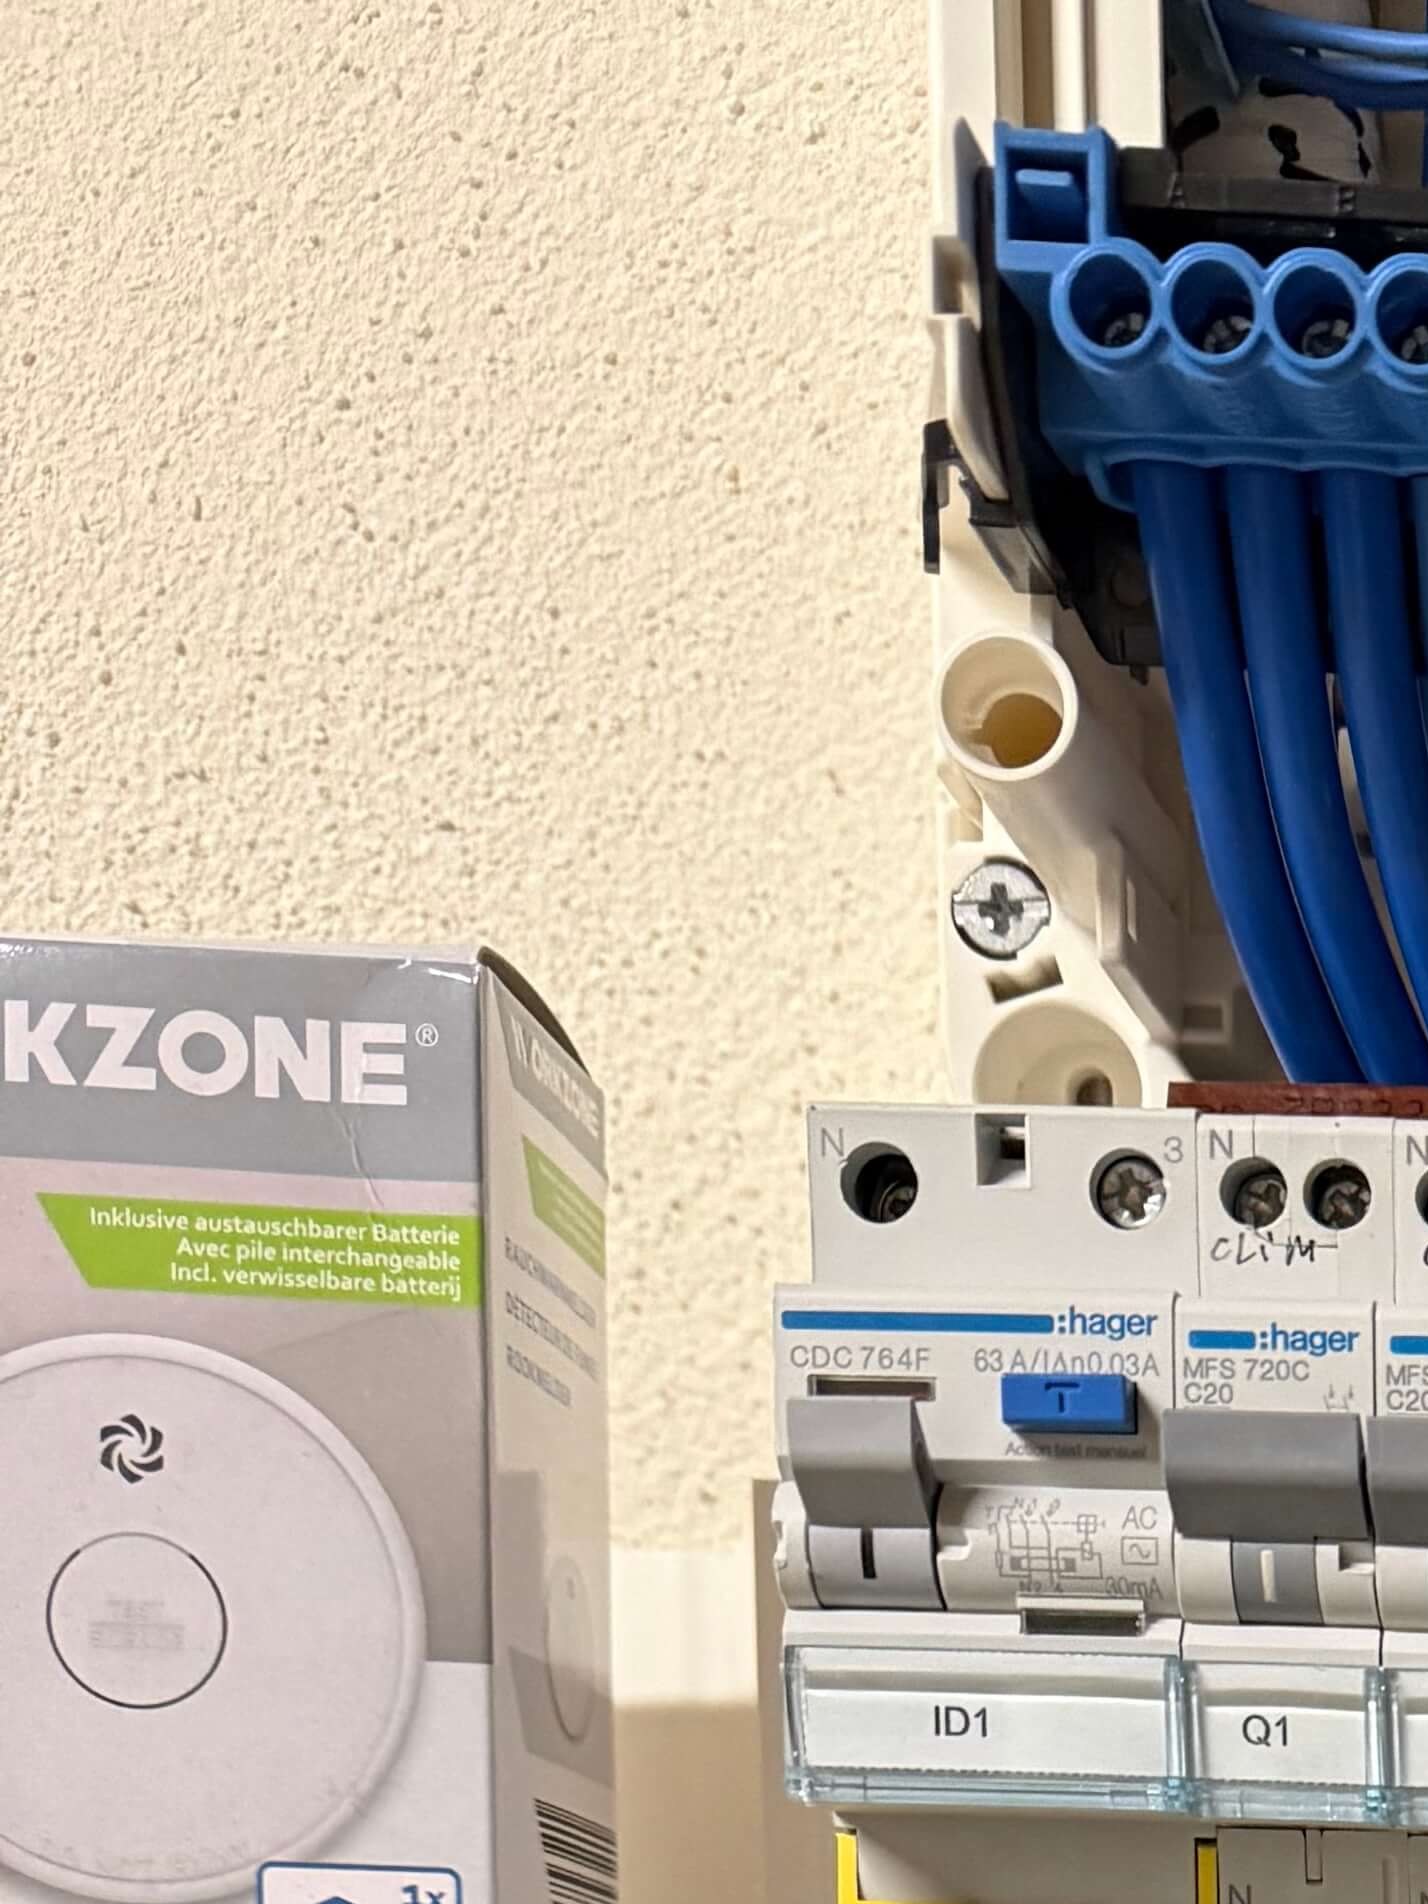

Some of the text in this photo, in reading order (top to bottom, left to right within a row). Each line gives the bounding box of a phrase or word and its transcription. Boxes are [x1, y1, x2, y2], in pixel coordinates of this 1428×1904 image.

[90, 1207, 459, 1244] Inklusive austauschbarer Batterie
[177, 1238, 460, 1273] Avec pile interchangeable
[171, 1263, 461, 1301] Incl. verwisselbare batterij
[934, 1706, 989, 1737] ID1
[1242, 1715, 1290, 1746] Q1
